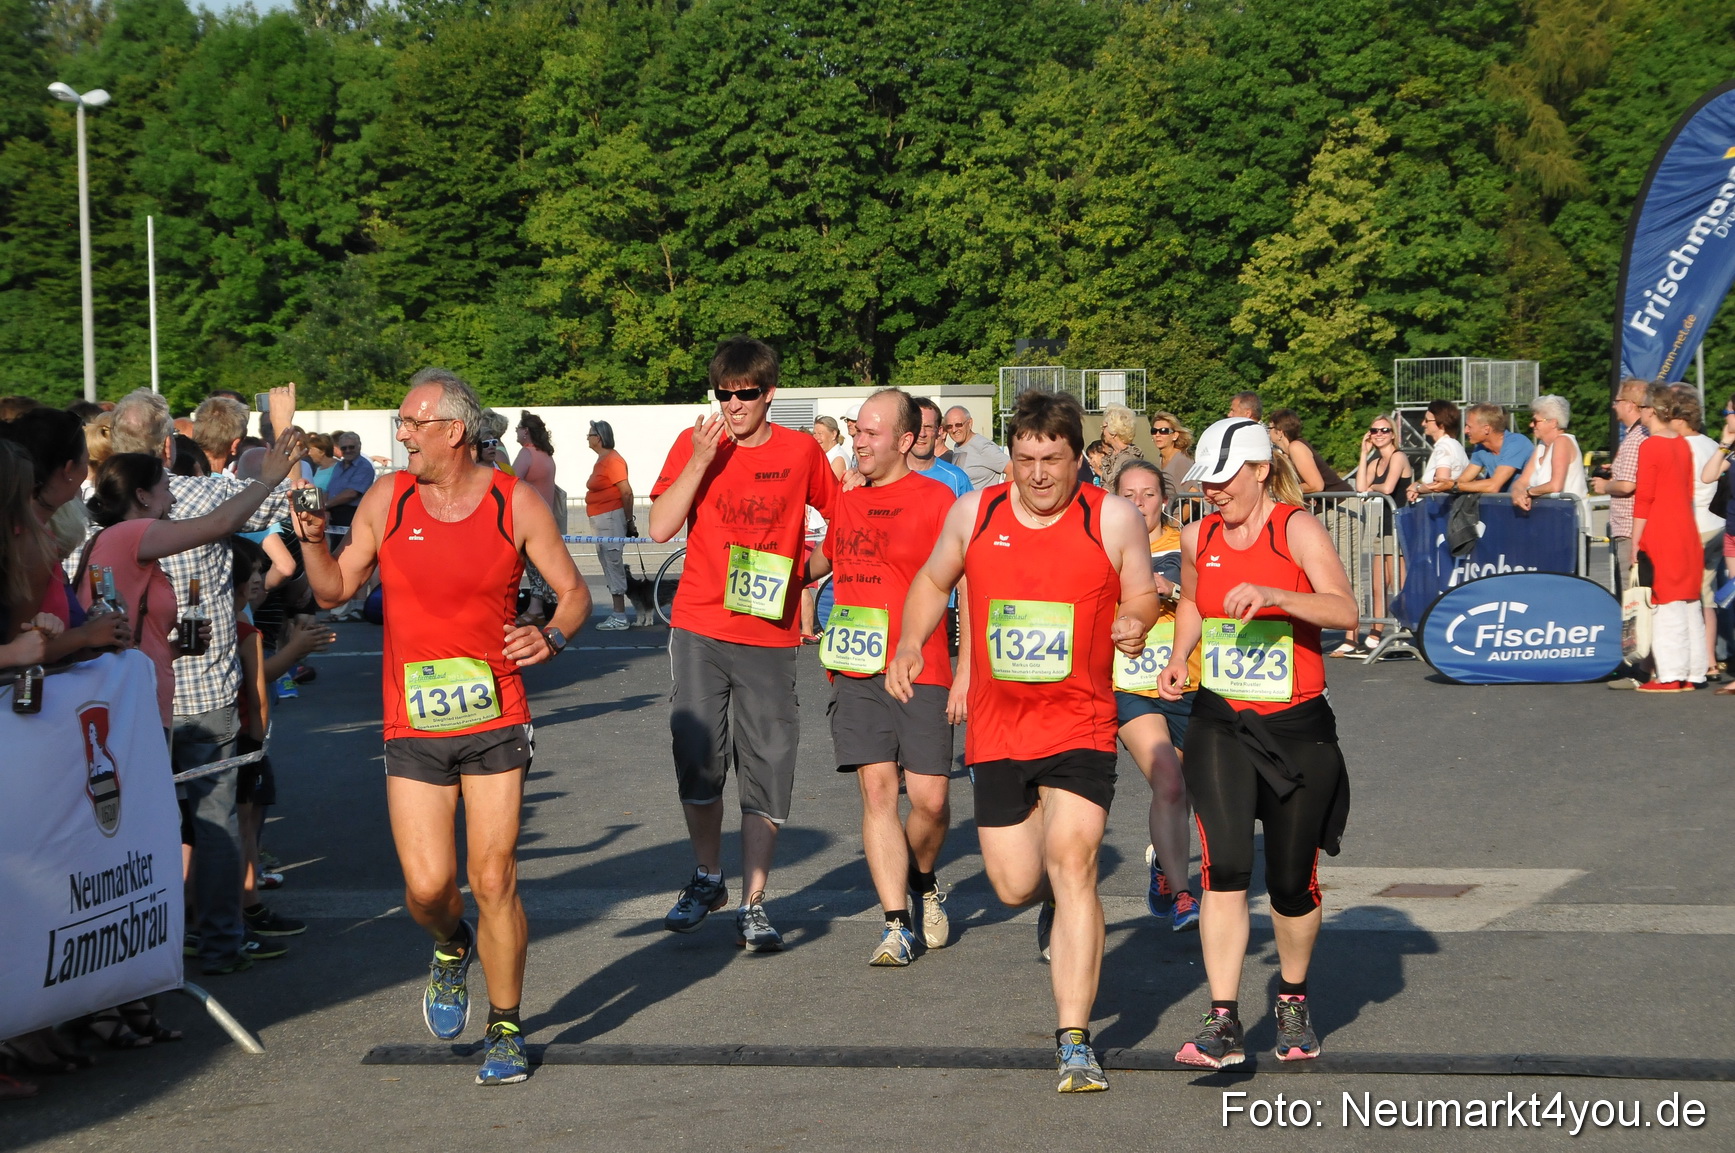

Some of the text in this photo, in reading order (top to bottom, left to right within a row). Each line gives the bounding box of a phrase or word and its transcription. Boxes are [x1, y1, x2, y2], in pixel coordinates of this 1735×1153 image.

[755, 471, 780, 480] swn
[867, 508, 890, 516] swn
[729, 569, 785, 602] 1357
[856, 573, 882, 585] läuft
[825, 627, 883, 658] 1356
[989, 628, 1069, 661] 1324
[1475, 621, 1605, 648] Fischer
[1205, 646, 1289, 681] 1323
[1487, 647, 1596, 662] AUTOMOBILE
[410, 684, 493, 718] 1313
[69, 850, 154, 915] Neumarkter
[43, 891, 168, 989] Lammsbräu
